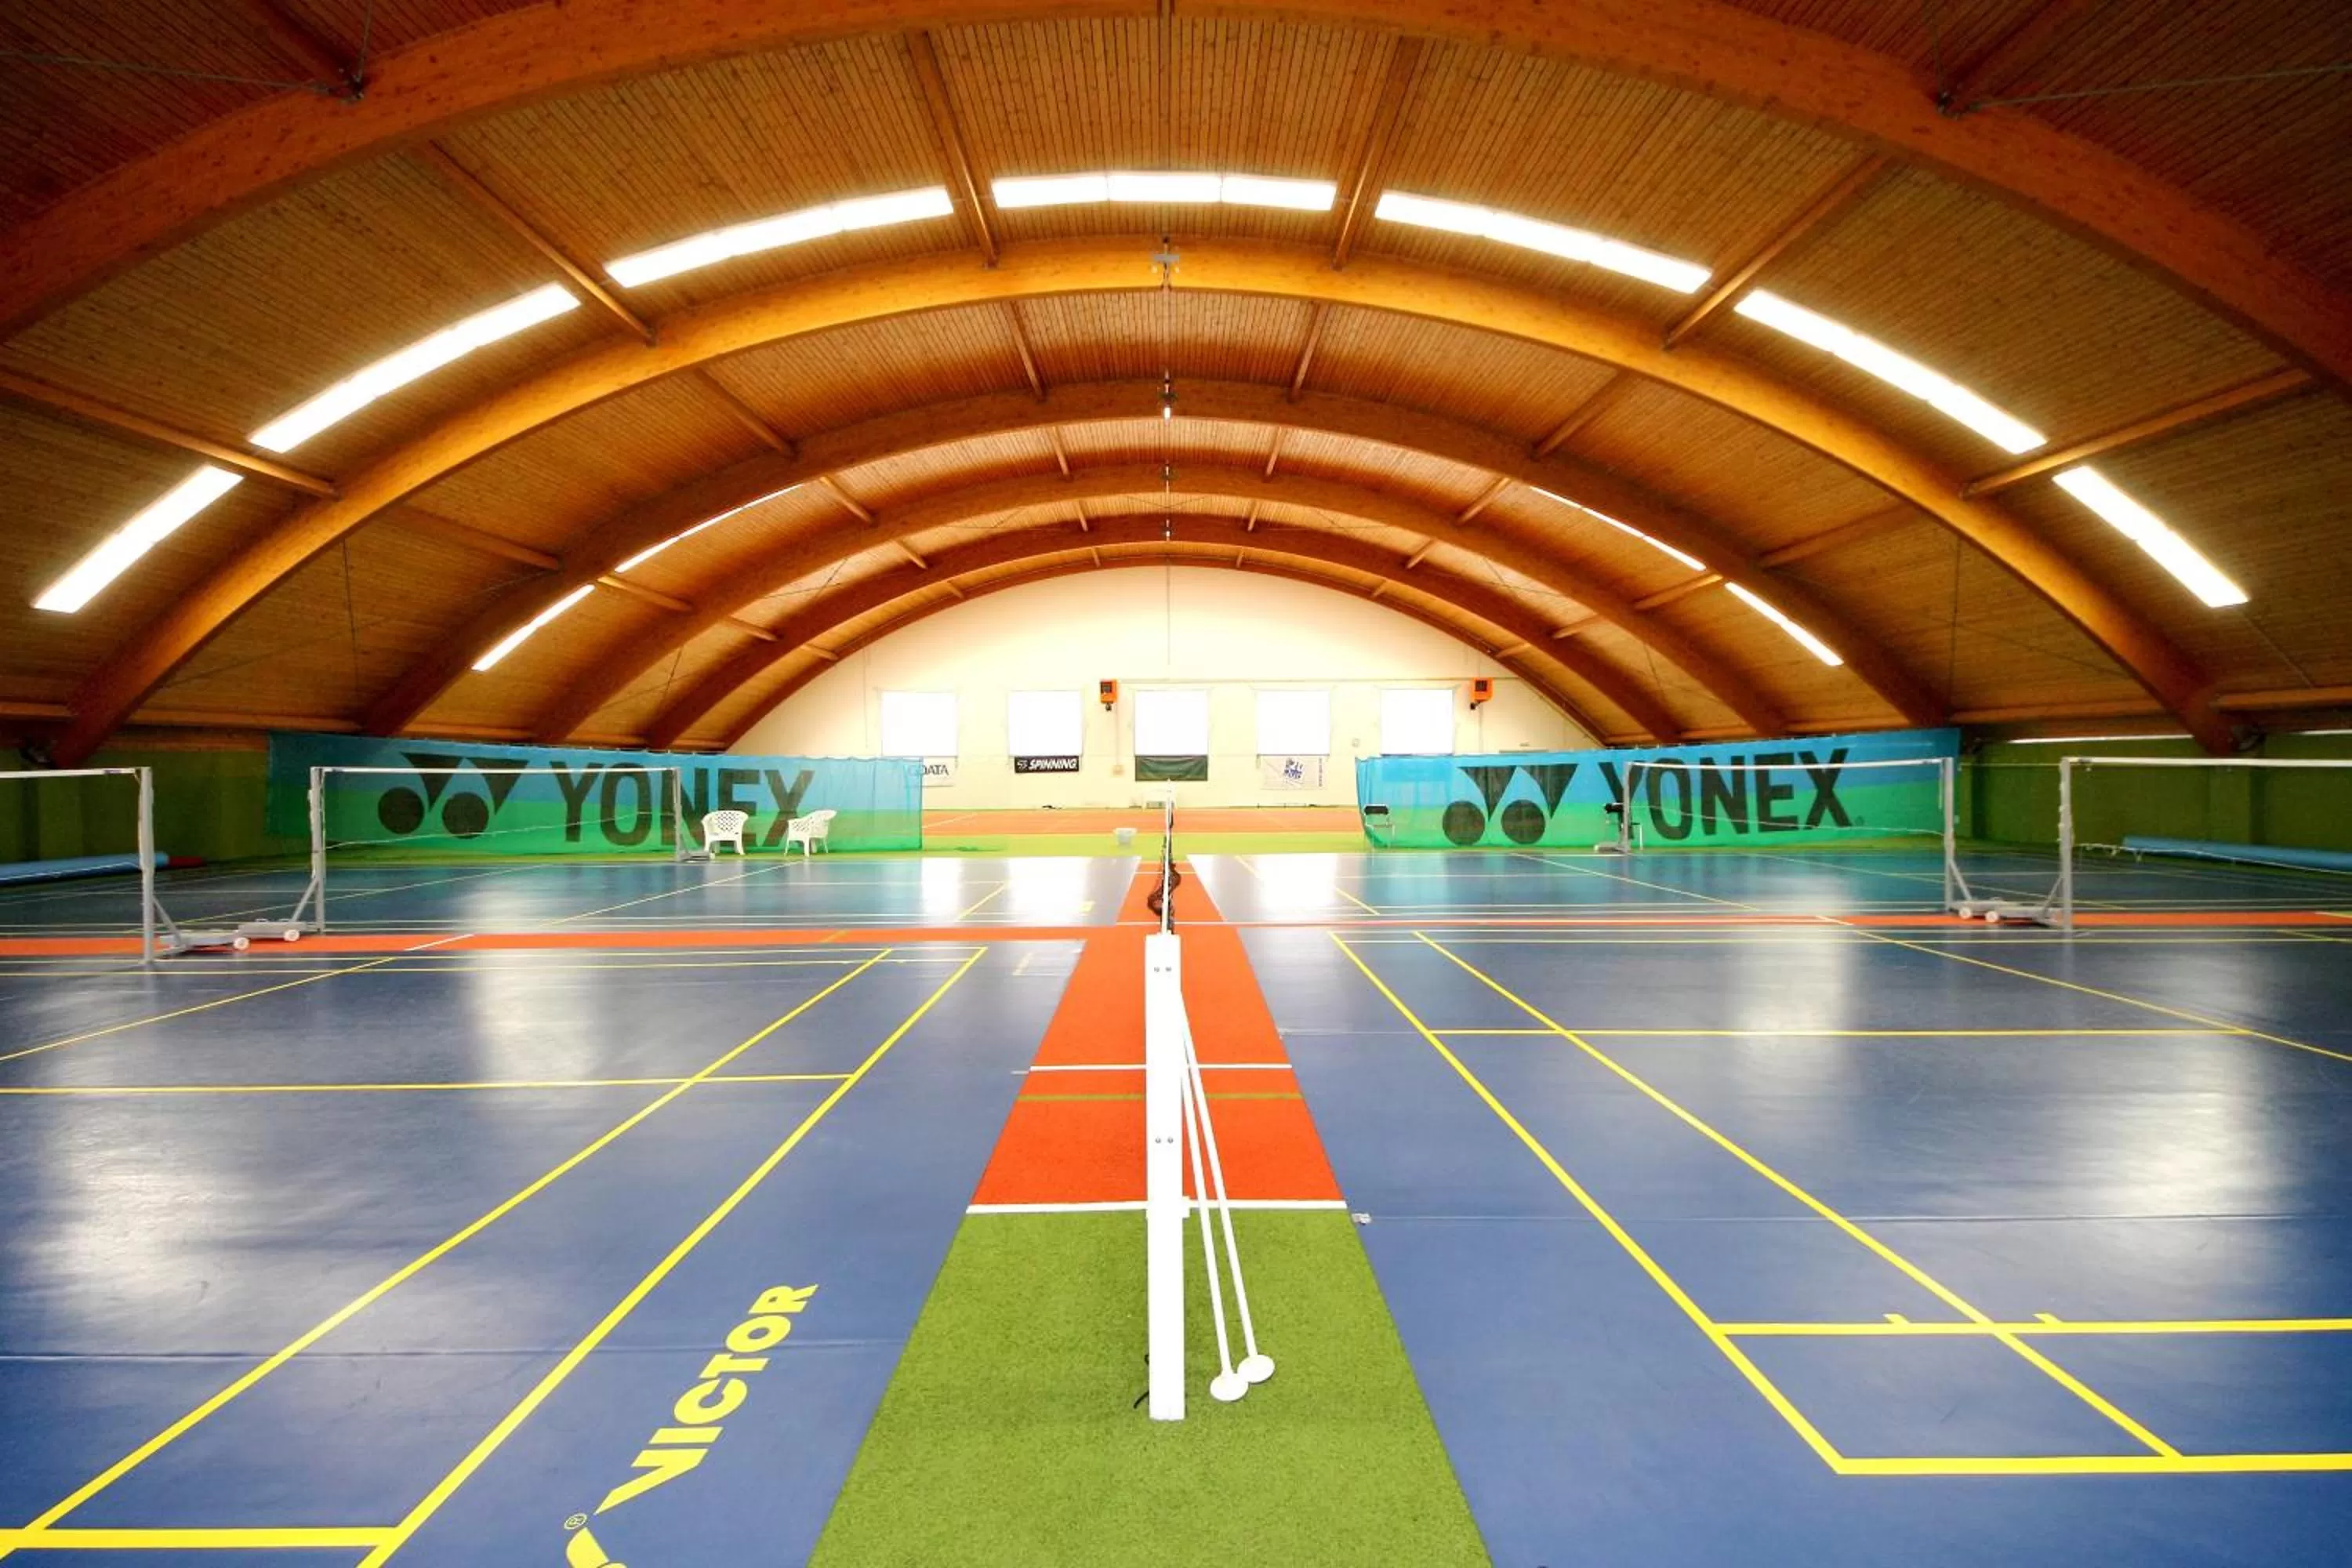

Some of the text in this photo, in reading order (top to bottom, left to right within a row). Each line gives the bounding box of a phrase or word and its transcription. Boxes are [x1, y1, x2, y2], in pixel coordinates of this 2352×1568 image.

[549, 760, 814, 848] YONEX
[1029, 758, 1077, 770] SPINNING
[1599, 748, 1852, 840] YONEX
[594, 1283, 818, 1515] VICTOR
